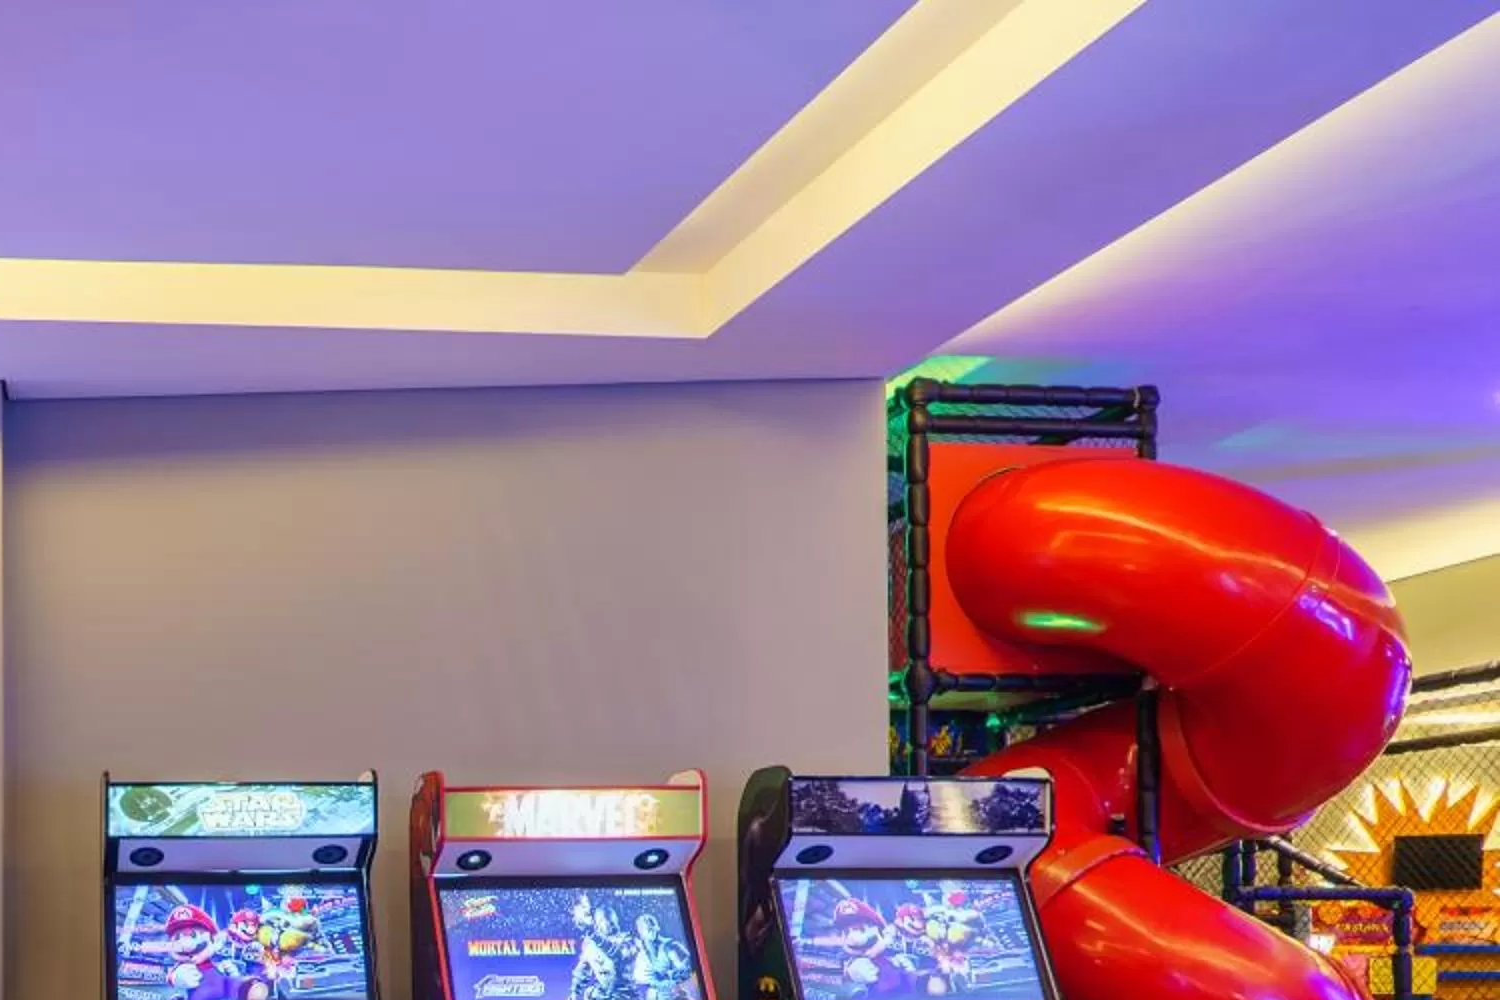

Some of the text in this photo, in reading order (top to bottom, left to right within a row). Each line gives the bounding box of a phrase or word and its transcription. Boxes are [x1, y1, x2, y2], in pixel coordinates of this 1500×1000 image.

[202, 794, 300, 813] STAR
[202, 811, 299, 829] WARS
[467, 937, 577, 957] MORTAL KOMBAT
